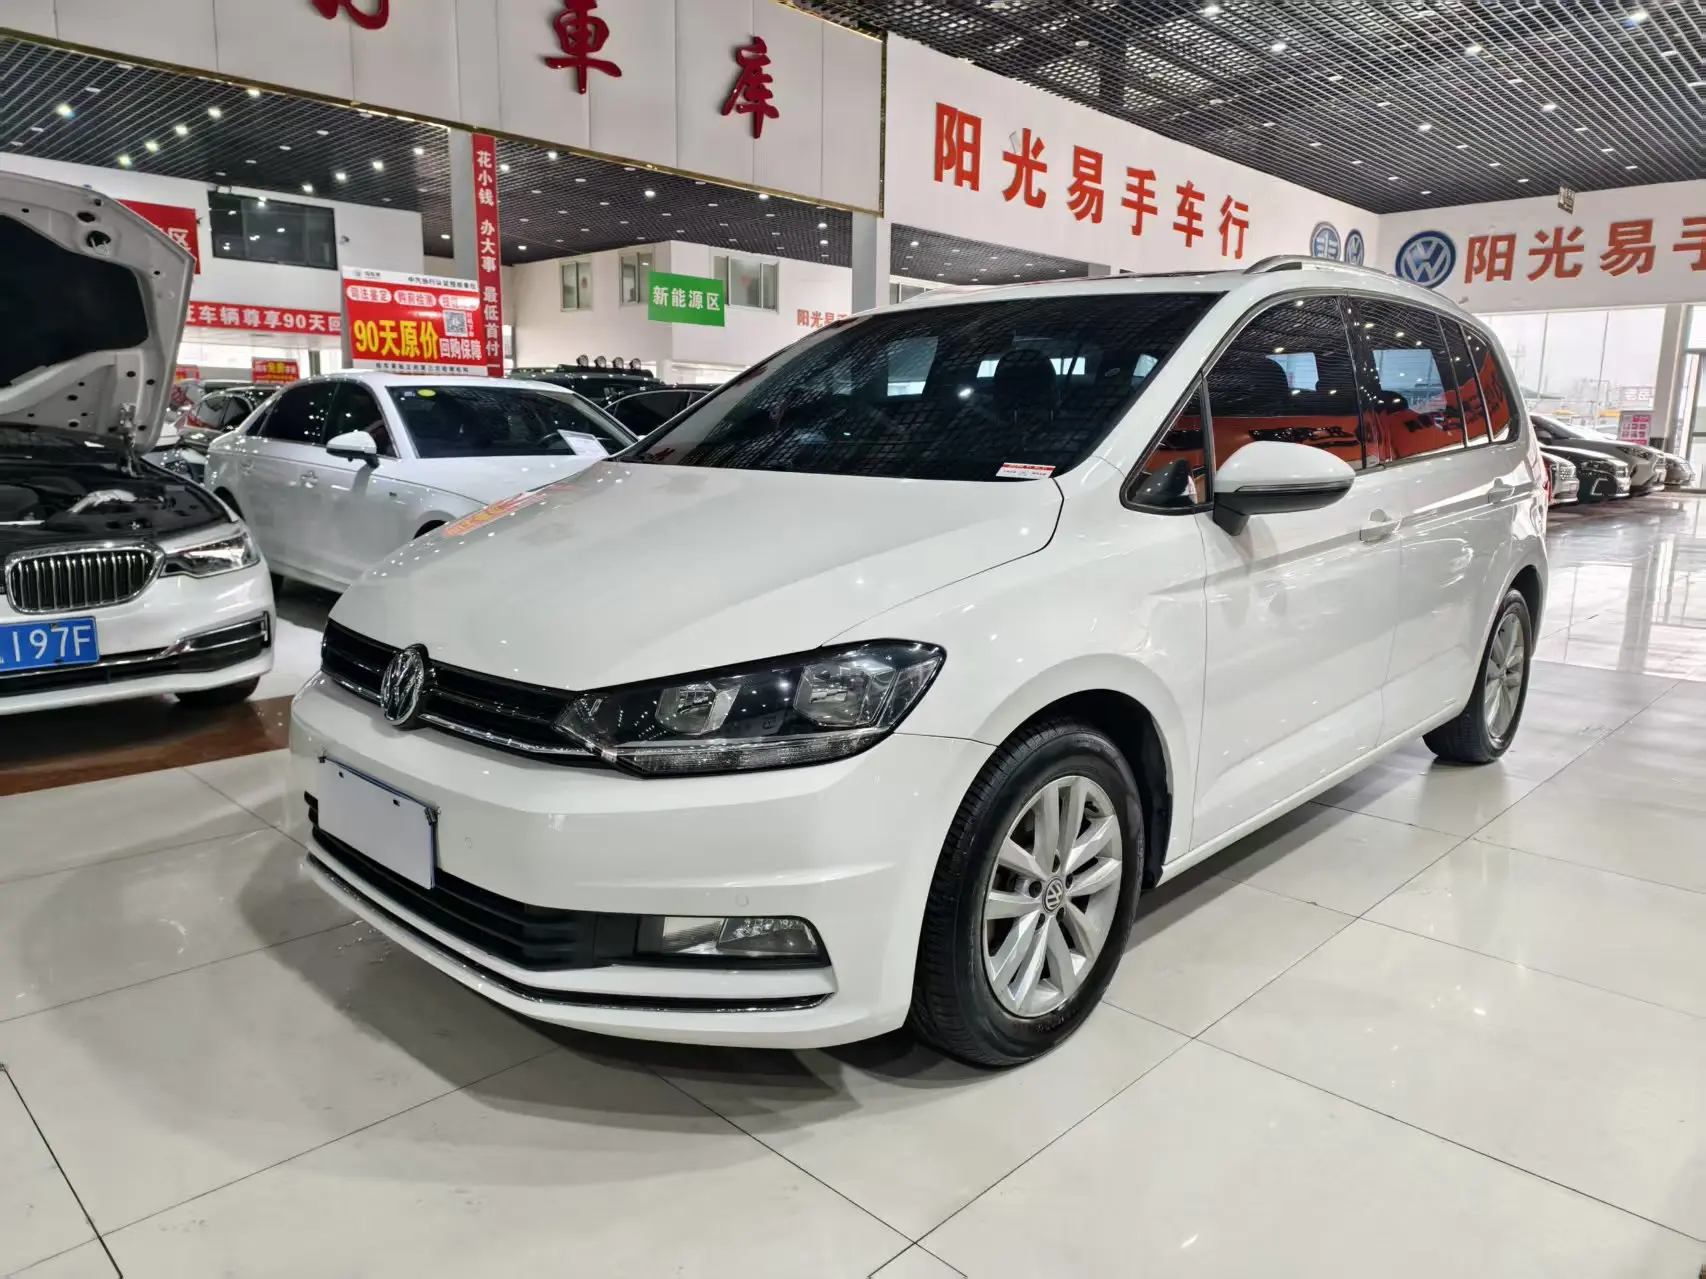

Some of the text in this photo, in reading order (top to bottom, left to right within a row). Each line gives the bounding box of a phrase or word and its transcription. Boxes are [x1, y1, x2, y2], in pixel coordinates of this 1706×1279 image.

[476, 150, 494, 206] 花小钱
[933, 102, 1249, 260] 阳光易手车行
[480, 219, 496, 272] 办大事
[652, 286, 721, 311] 新能源区
[353, 320, 438, 359] 90天原价
[439, 337, 482, 360] 回购保障
[0, 625, 91, 664] 197F
